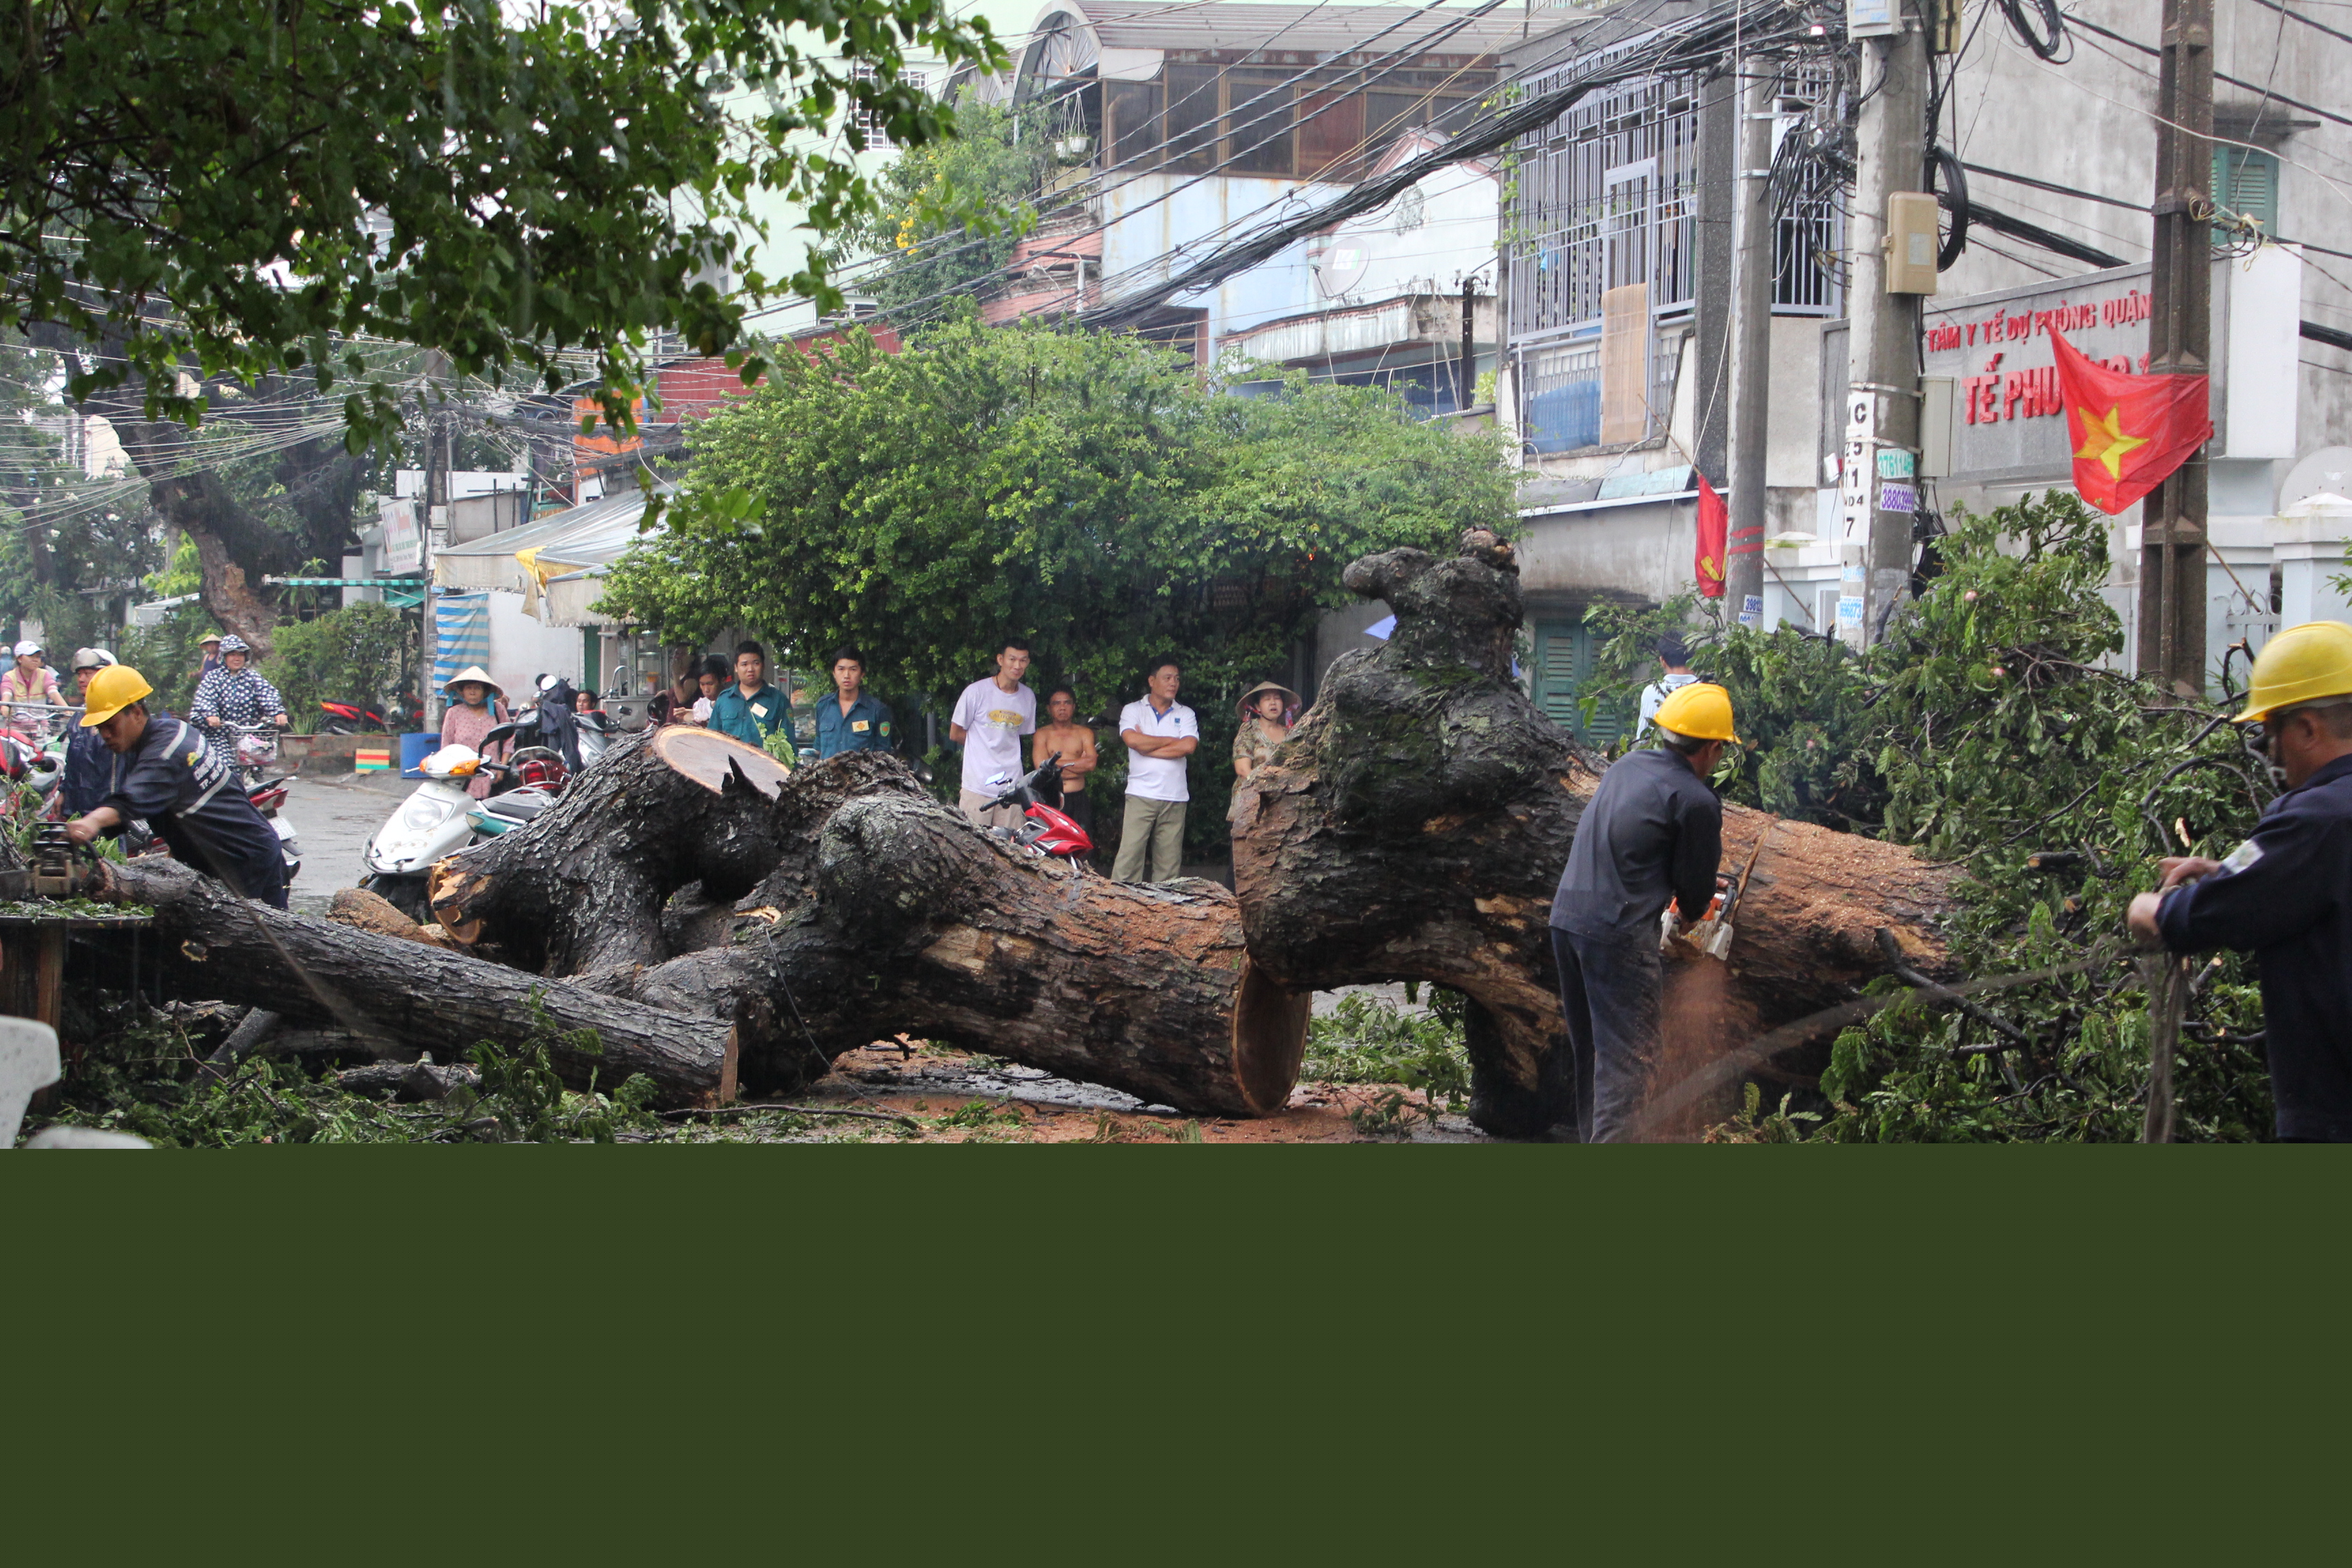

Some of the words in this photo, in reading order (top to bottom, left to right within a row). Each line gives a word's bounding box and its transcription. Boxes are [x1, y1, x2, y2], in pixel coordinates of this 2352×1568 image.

[1927, 321, 1961, 352] TÂM
[1966, 323, 1976, 346] Y
[1982, 308, 2006, 344] TẾ
[2007, 309, 2033, 345] DỰ
[2102, 289, 2152, 328] QUẬN
[1961, 353, 2004, 425] TẾ
